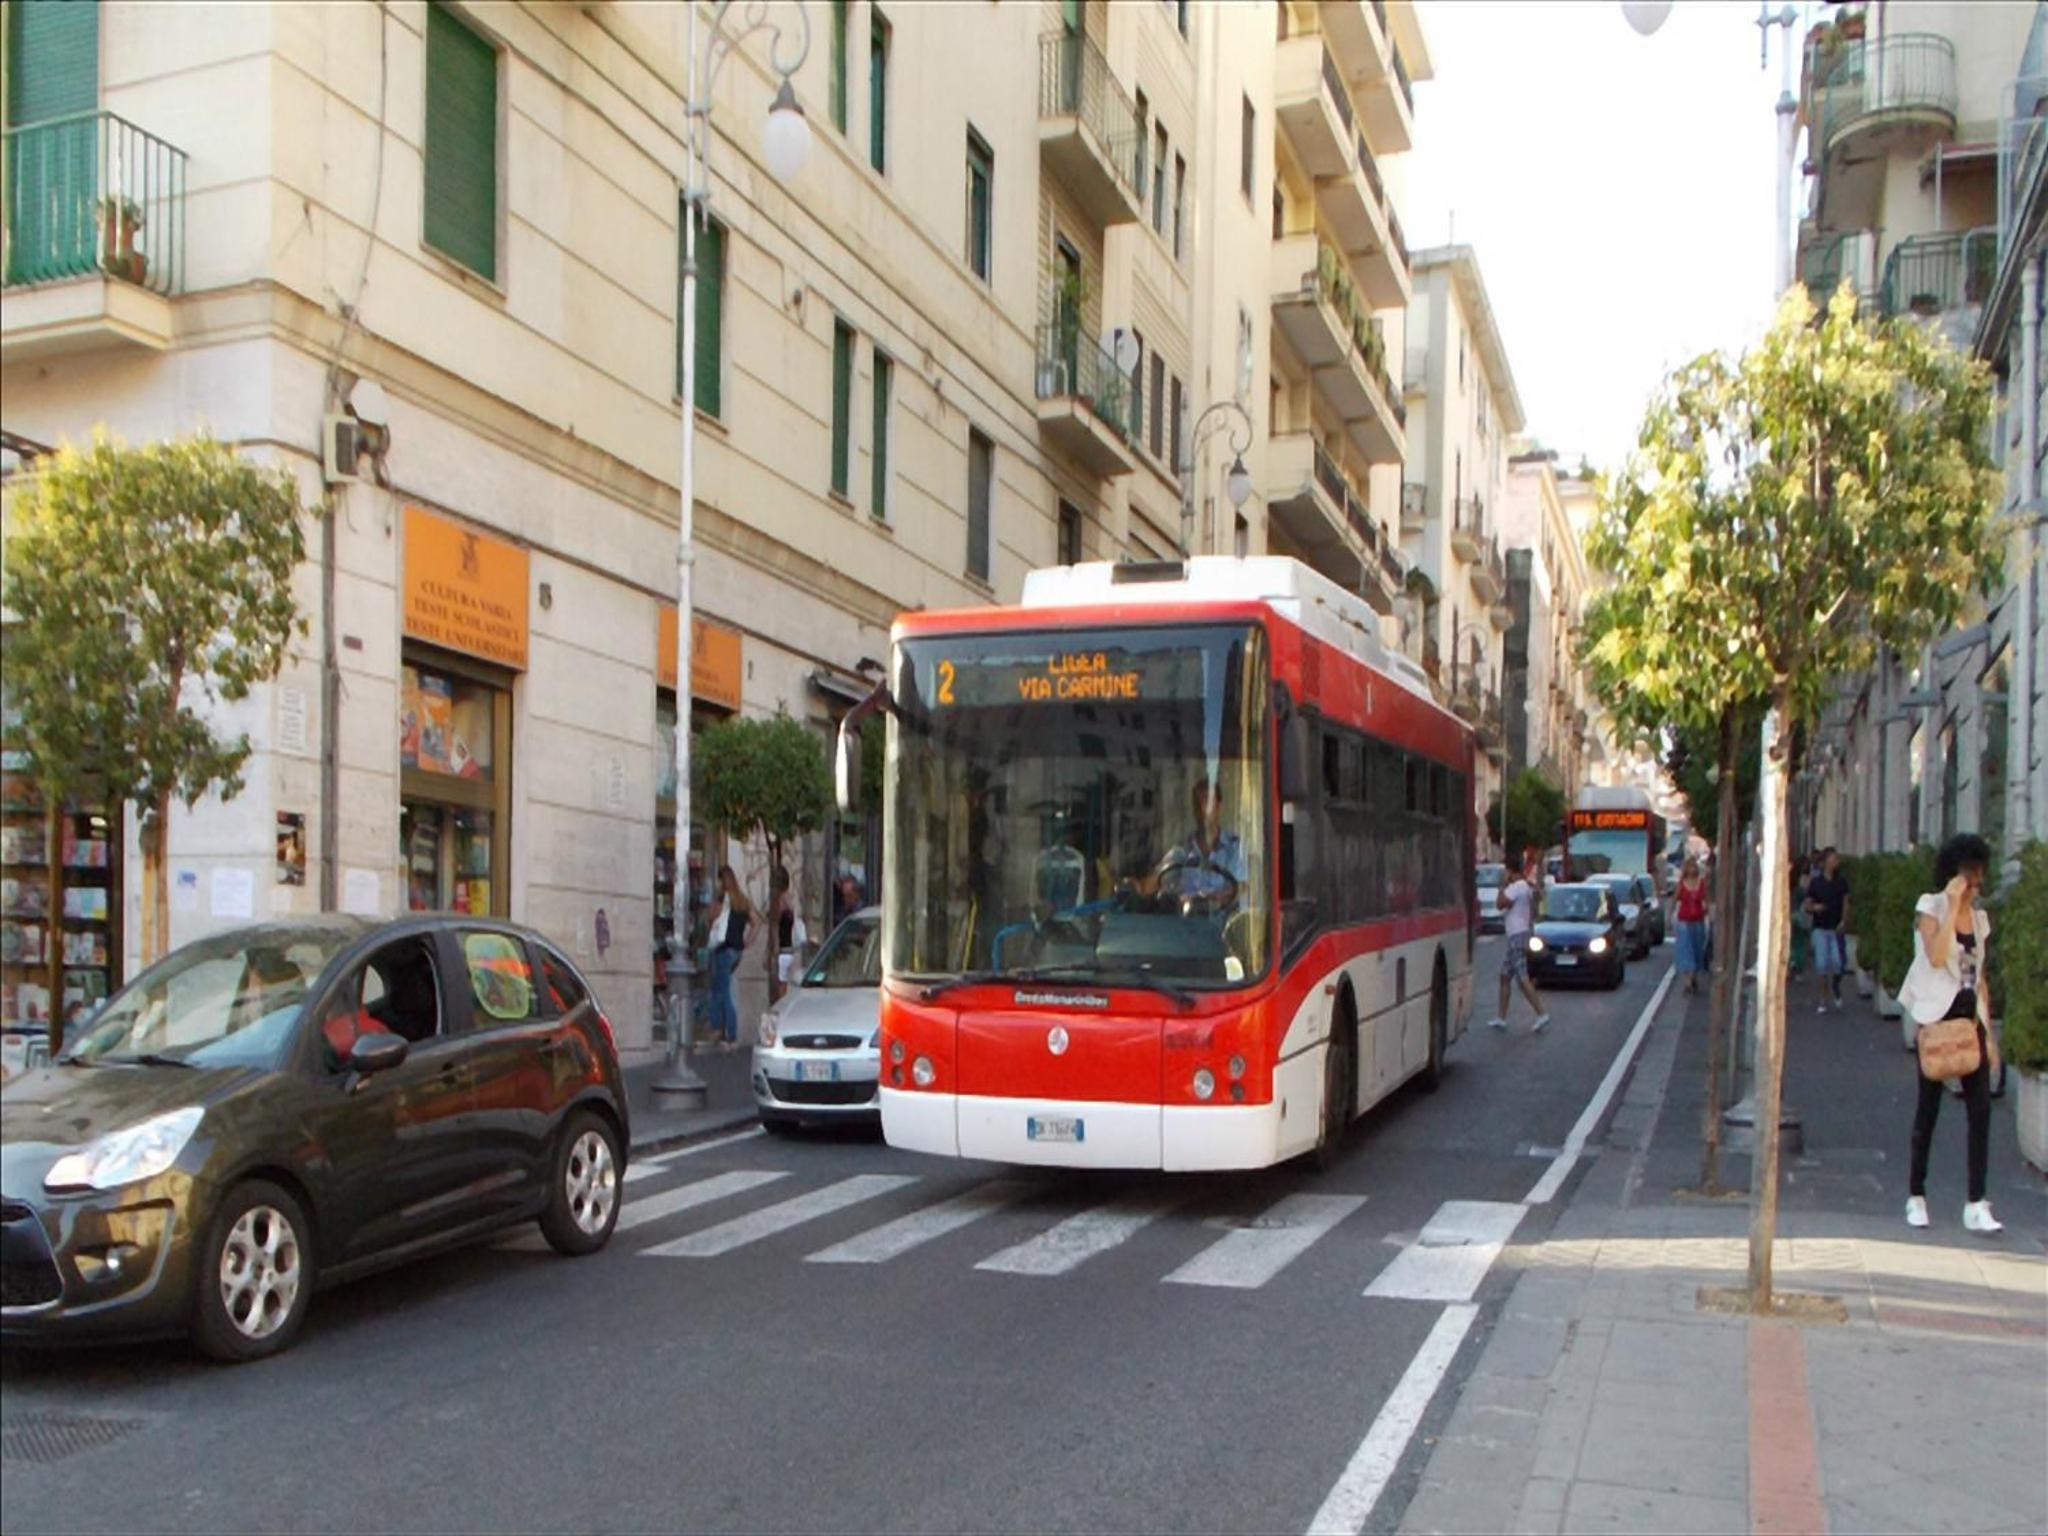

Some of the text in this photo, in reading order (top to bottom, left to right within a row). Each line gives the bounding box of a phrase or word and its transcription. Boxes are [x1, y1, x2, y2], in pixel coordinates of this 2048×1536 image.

[406, 616, 440, 639] TESTI
[414, 597, 519, 643] TESTI SCOLASTICI
[938, 658, 955, 704] 2
[1018, 672, 1139, 699] VIA CARMINE
